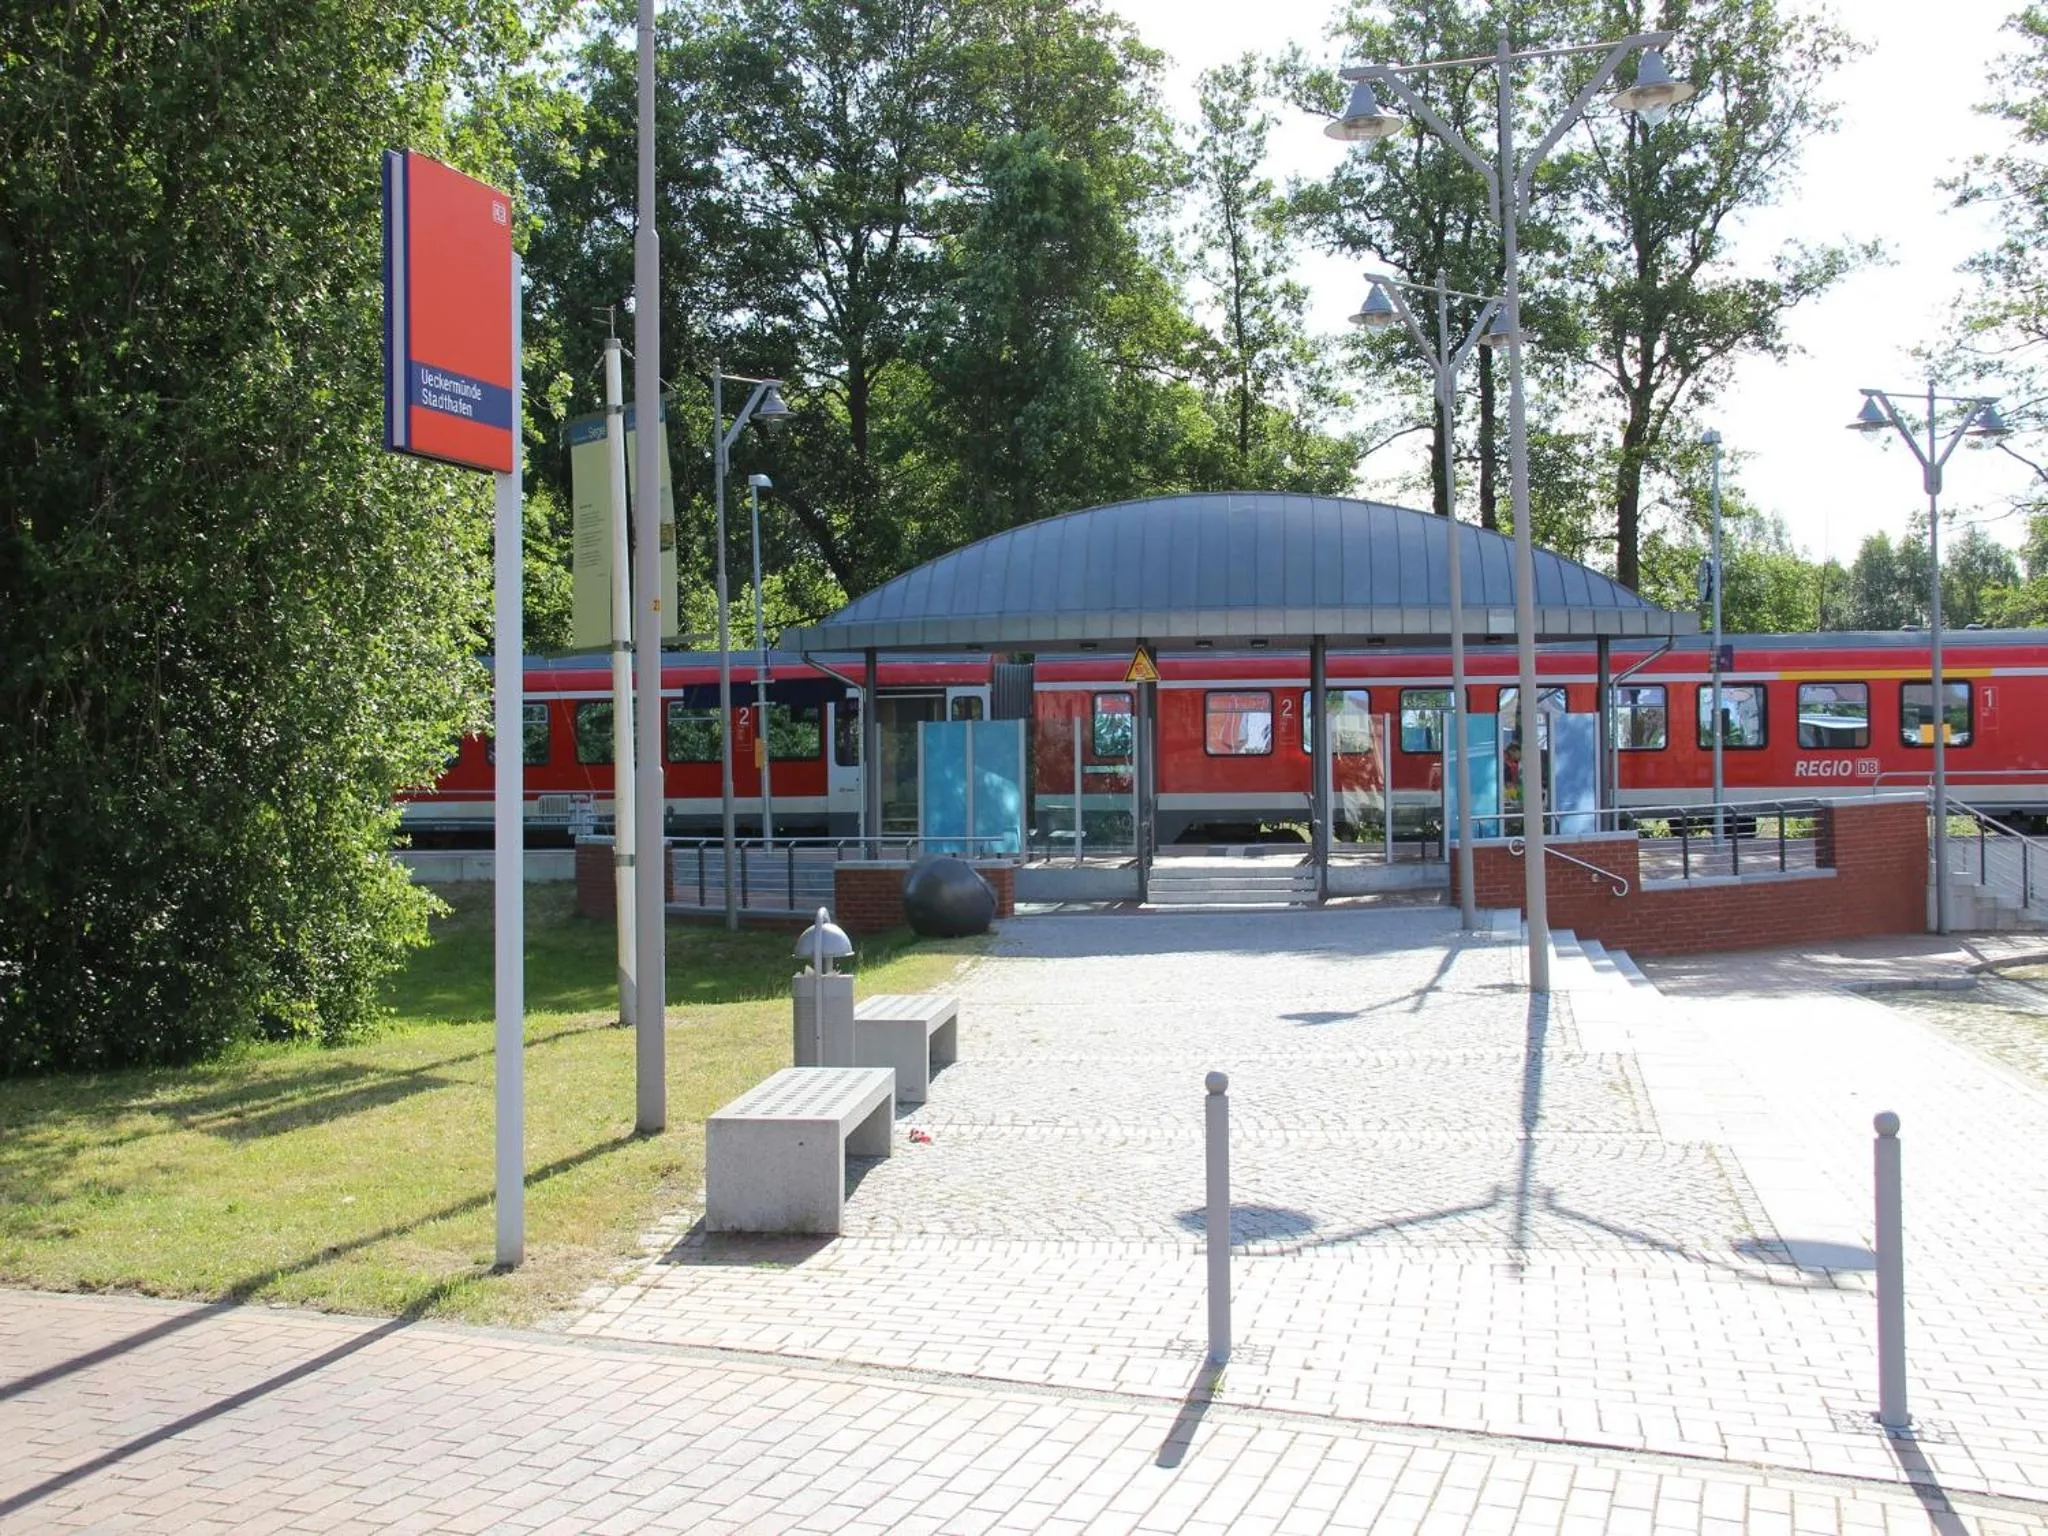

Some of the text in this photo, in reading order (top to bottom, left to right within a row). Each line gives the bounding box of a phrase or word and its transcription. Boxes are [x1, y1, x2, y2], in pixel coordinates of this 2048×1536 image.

[421, 368, 482, 400] Ueckermünde
[421, 388, 473, 417] Stadthafen
[1281, 698, 1293, 717] 2
[1984, 688, 1992, 708] 1
[739, 707, 749, 725] 2
[1795, 759, 1878, 777] REGIO DB
